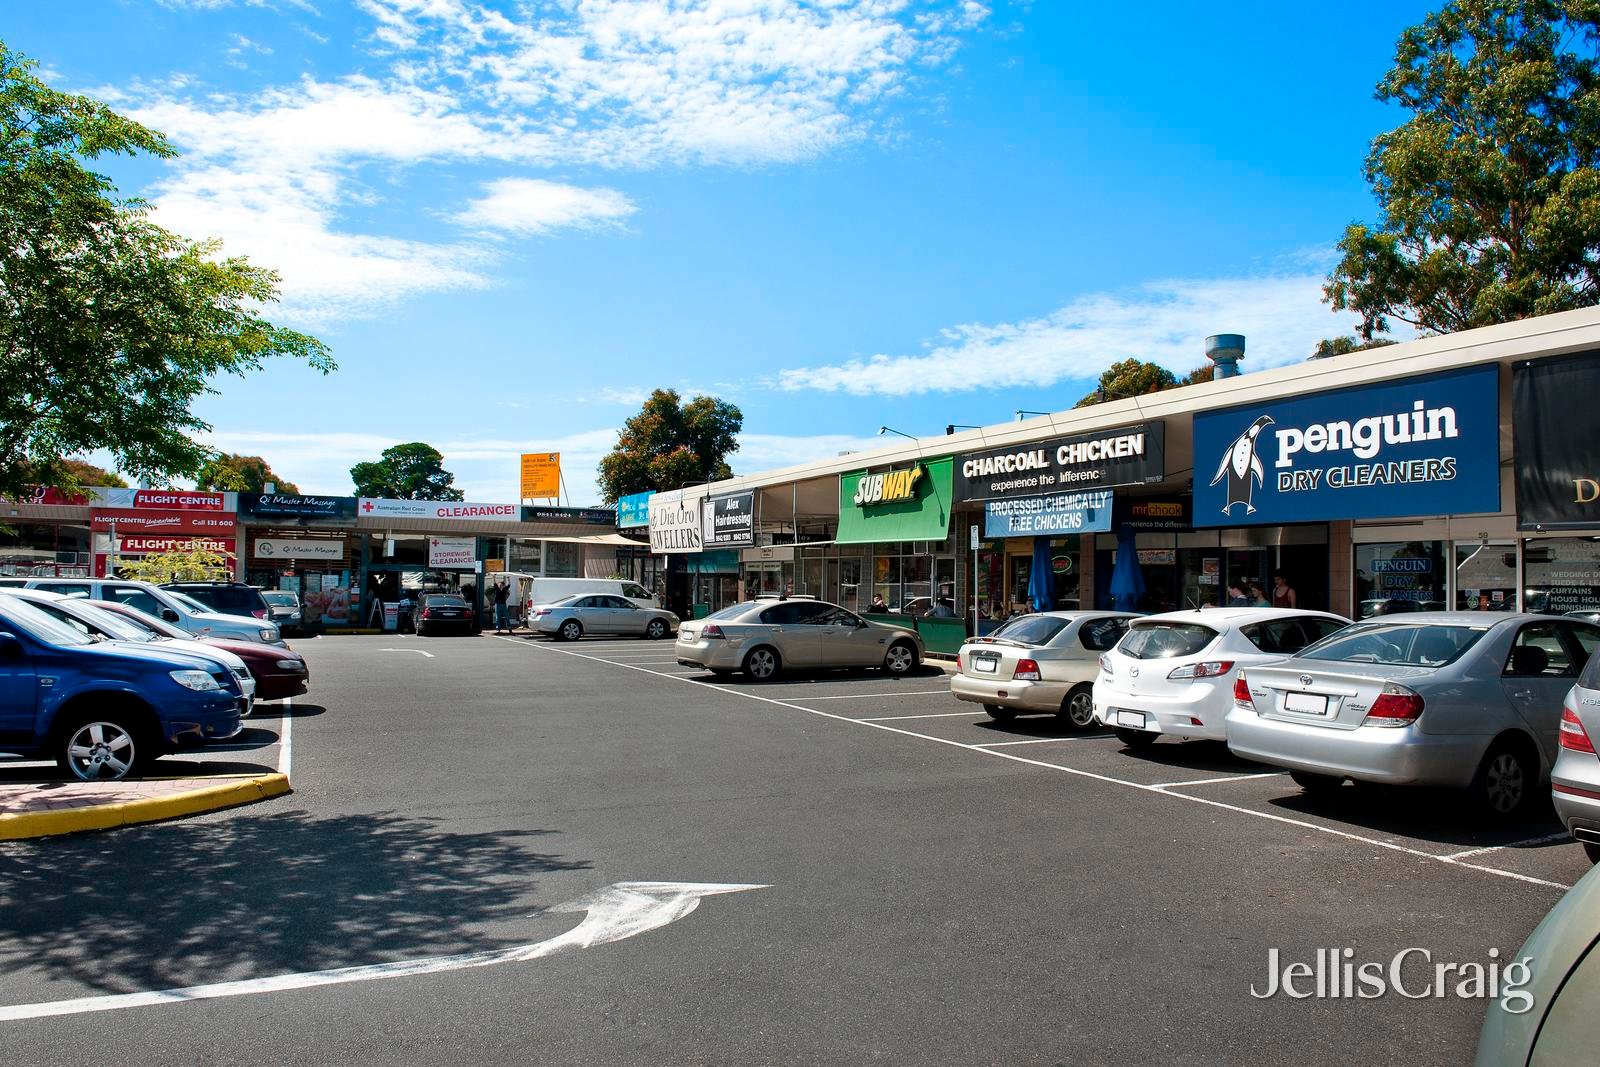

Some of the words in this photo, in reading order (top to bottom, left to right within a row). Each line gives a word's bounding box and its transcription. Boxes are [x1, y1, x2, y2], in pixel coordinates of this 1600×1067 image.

[1275, 399, 1458, 468] penguin
[962, 449, 1050, 479] CHARCOAL
[1056, 433, 1145, 466] CHICKEN
[1039, 474, 1055, 485] the
[1278, 468, 1323, 493] DRY
[1325, 456, 1457, 489] CLEANERS
[853, 466, 922, 504] SUBWAY
[1572, 479, 1600, 503] D
[138, 495, 178, 504] FLIGHT
[179, 496, 220, 505] CENTRE
[259, 495, 271, 505] Qi
[272, 496, 300, 505] Master
[303, 497, 336, 508] Massage
[726, 498, 739, 510] Alex
[989, 498, 1044, 517] PROCESSED
[1045, 492, 1108, 513] CHEMICALLY
[437, 505, 515, 518] CLEARANCE!
[660, 506, 675, 526] Dia
[677, 507, 694, 525] Oro
[715, 512, 751, 527] Hairdressing
[1008, 514, 1033, 532] FREE
[1034, 512, 1082, 530] CHICKENS
[127, 539, 173, 549] FLIGHT
[176, 540, 226, 550] CENTRE
[314, 547, 338, 556] Massage
[434, 550, 471, 558] STOREWIDE
[430, 557, 475, 565] CLEARANCE!
[1374, 560, 1426, 571] PENGUIN
[1385, 575, 1415, 587] DRY
[1368, 590, 1434, 601] CLEANERS
[1550, 587, 1592, 595] CURTAINS
[1550, 595, 1579, 603] HOUSE
